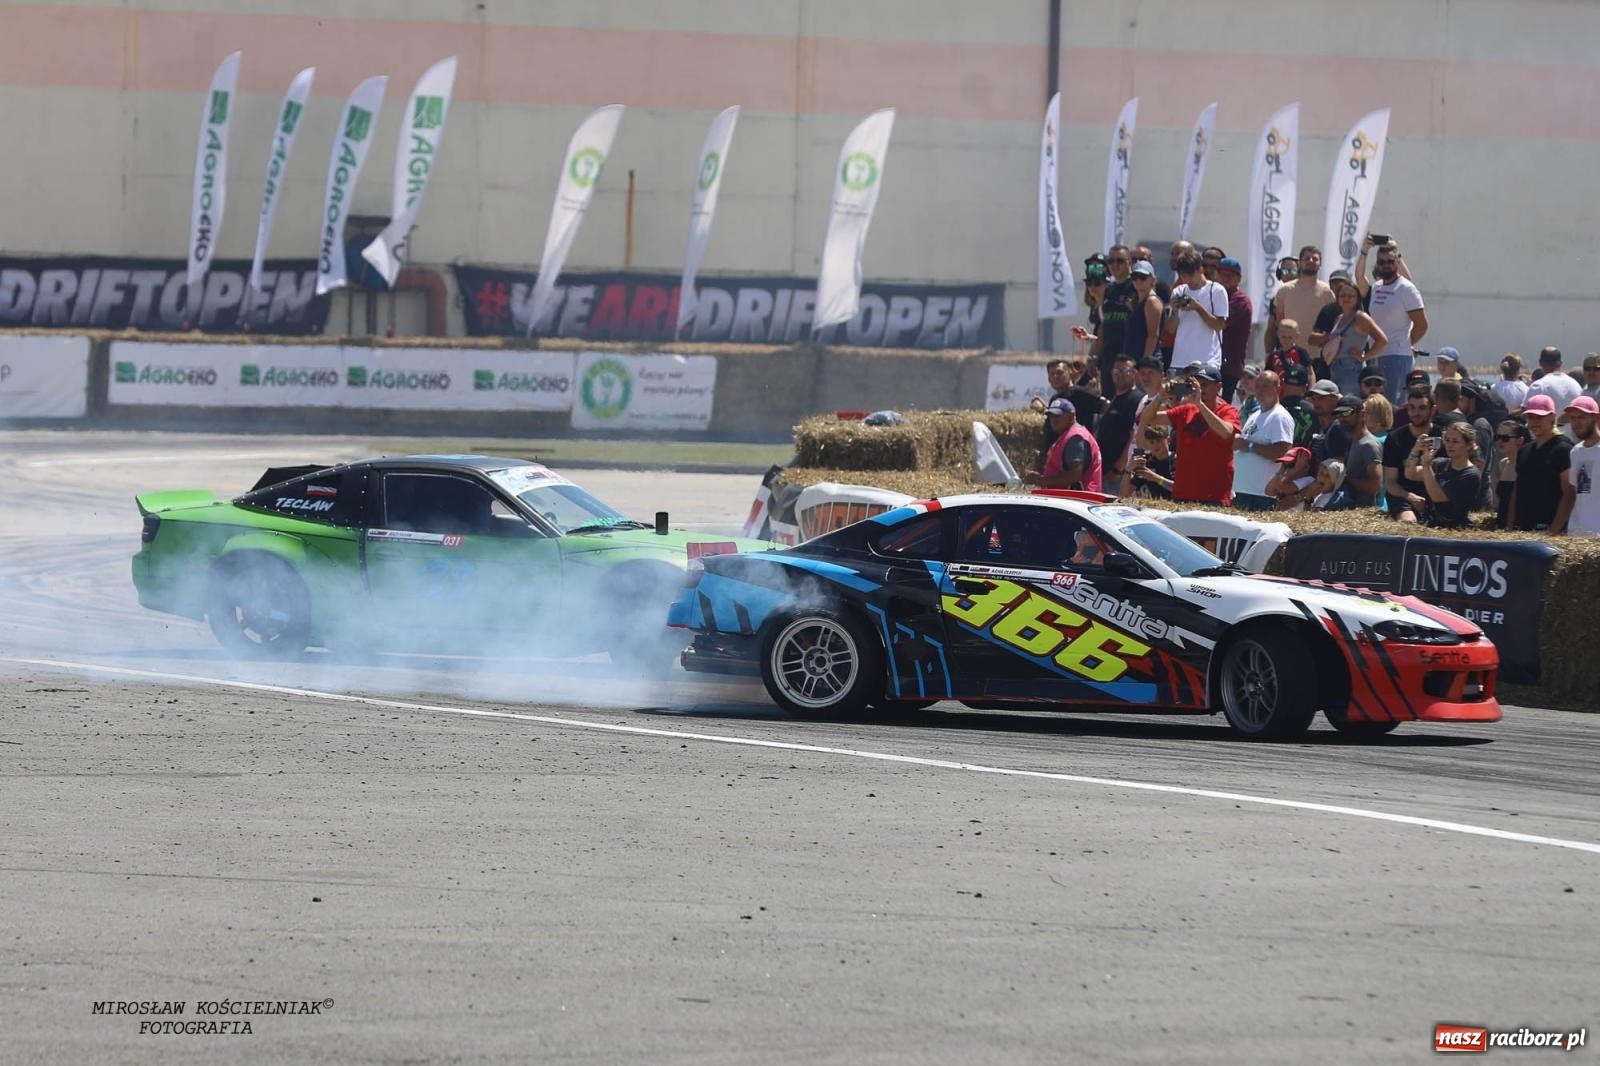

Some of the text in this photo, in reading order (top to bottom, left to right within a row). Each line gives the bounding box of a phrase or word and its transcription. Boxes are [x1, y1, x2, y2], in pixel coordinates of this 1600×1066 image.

[139, 365, 218, 386] AGROEKO
[262, 367, 339, 388] AGROEKO
[369, 368, 451, 390] AGROEKO
[497, 372, 569, 393] AGROEKO
[443, 535, 461, 546] 031
[1319, 560, 1392, 576] AUTO FUS
[1411, 553, 1509, 599] INEOS
[1053, 574, 1075, 586] 366
[1186, 588, 1222, 599] SHOP
[941, 575, 1152, 682] 366
